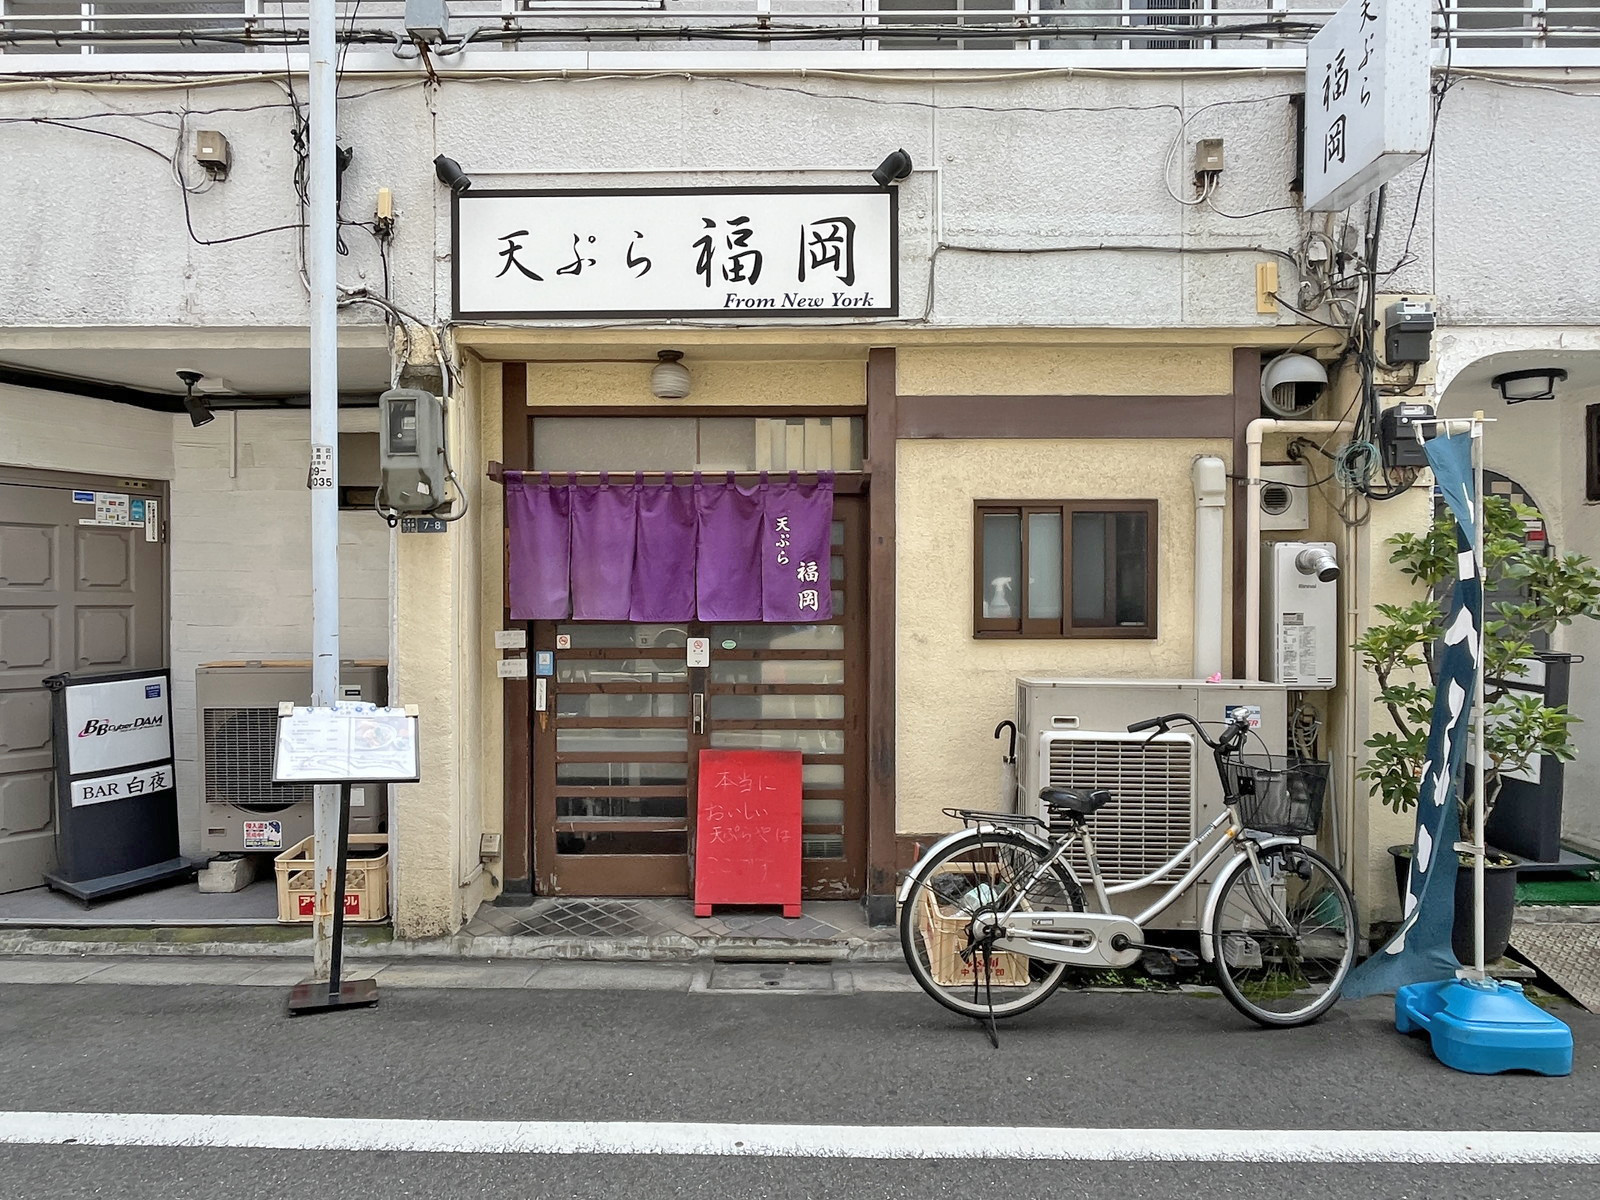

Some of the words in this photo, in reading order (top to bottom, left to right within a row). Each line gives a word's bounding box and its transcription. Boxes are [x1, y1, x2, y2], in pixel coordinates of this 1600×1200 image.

[1322, 48, 1349, 174] 福岡
[495, 228, 652, 283] 天ぷら
[692, 215, 856, 289] 福岡
[722, 293, 775, 308] From
[783, 293, 825, 308] New
[832, 292, 875, 307] York
[423, 521, 441, 530] 7-8
[797, 561, 819, 612] 福岡
[133, 715, 163, 728] DAM
[82, 783, 120, 800] BAR
[126, 771, 168, 795] 白夜
[714, 771, 777, 793] 本当に
[704, 802, 769, 822] おいしい
[709, 825, 792, 844] 天ぷらやは
